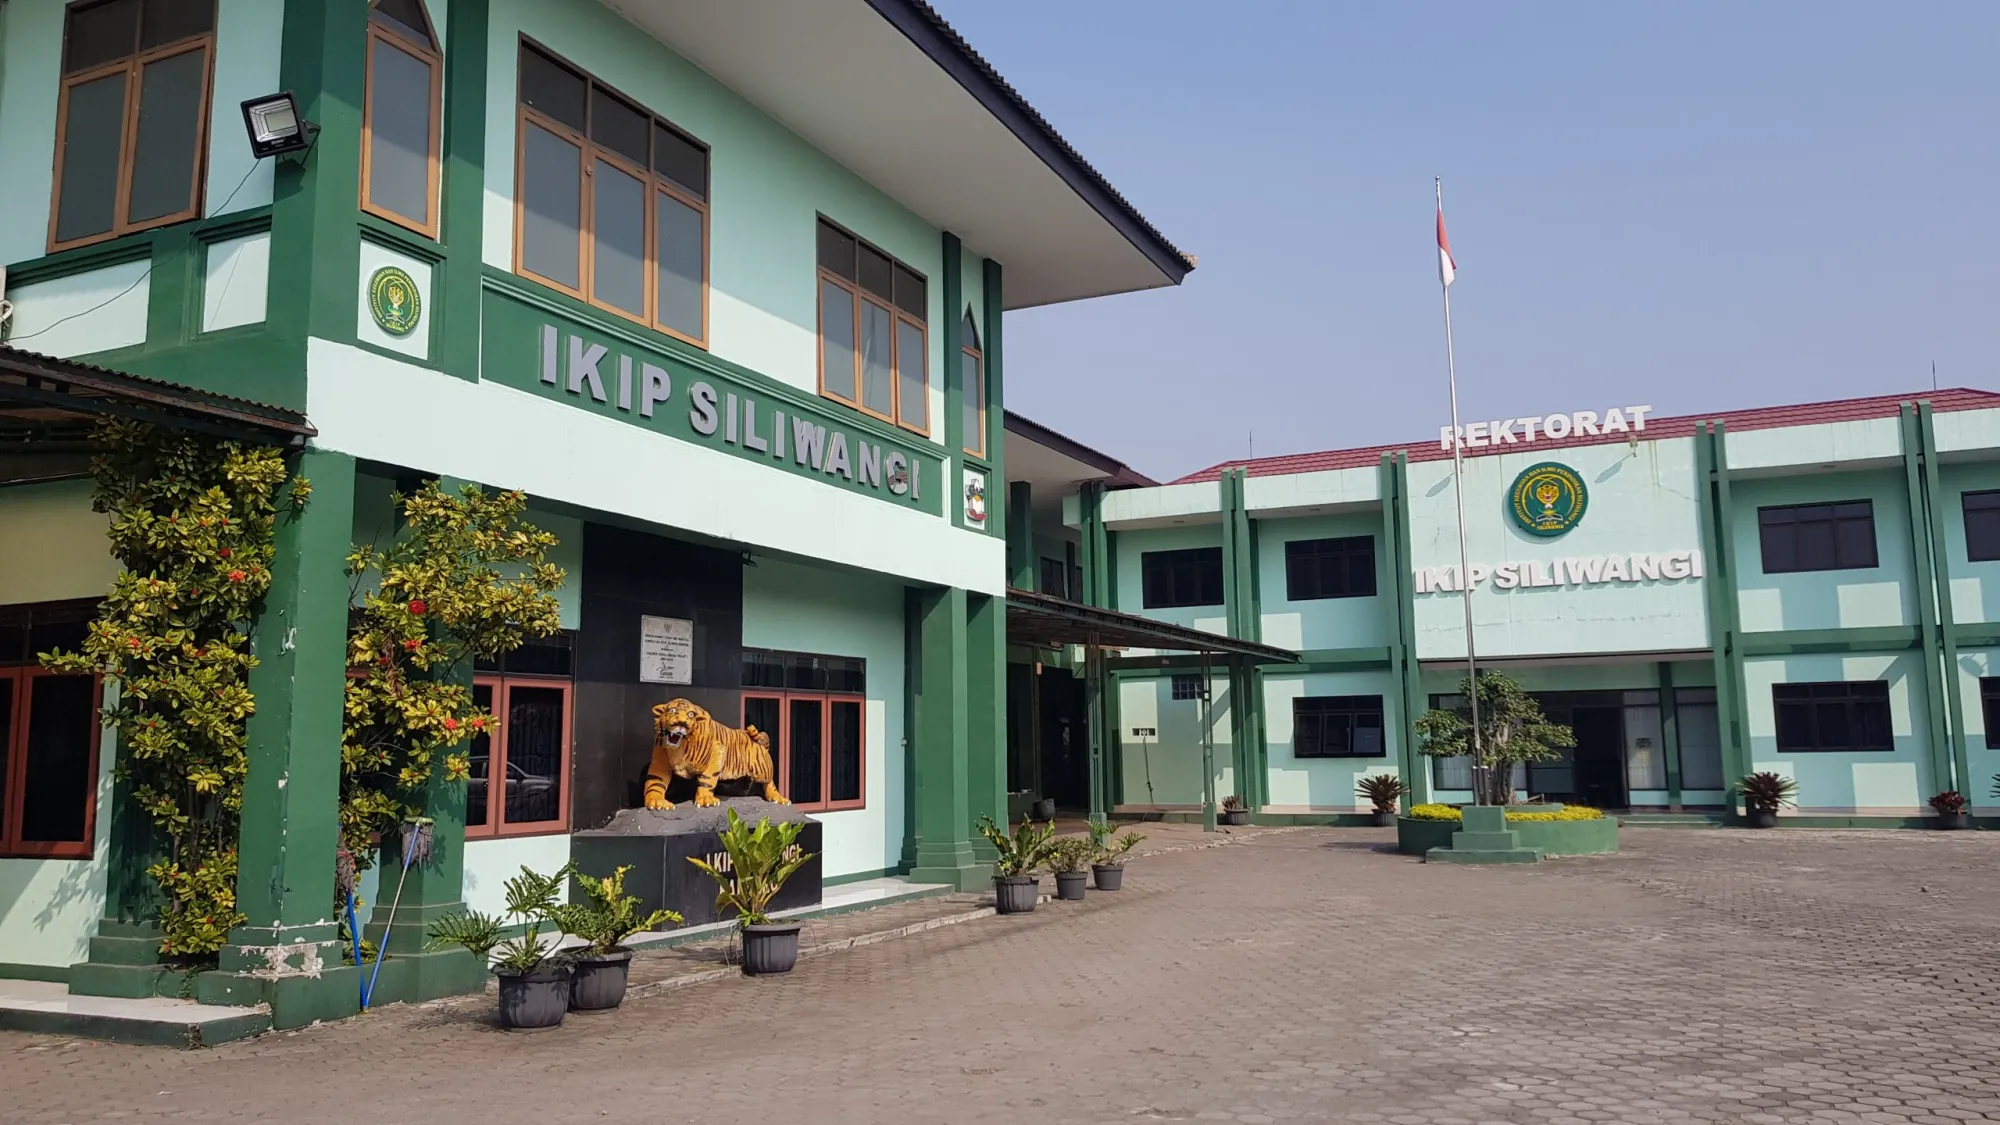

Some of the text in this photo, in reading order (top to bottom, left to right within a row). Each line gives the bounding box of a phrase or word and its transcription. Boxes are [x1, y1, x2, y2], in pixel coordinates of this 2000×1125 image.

[539, 323, 921, 500] IKIP SILIWANGI
[1440, 404, 1653, 451] REKTORAT
[1413, 549, 1703, 593] IKIP SILIWANGI
